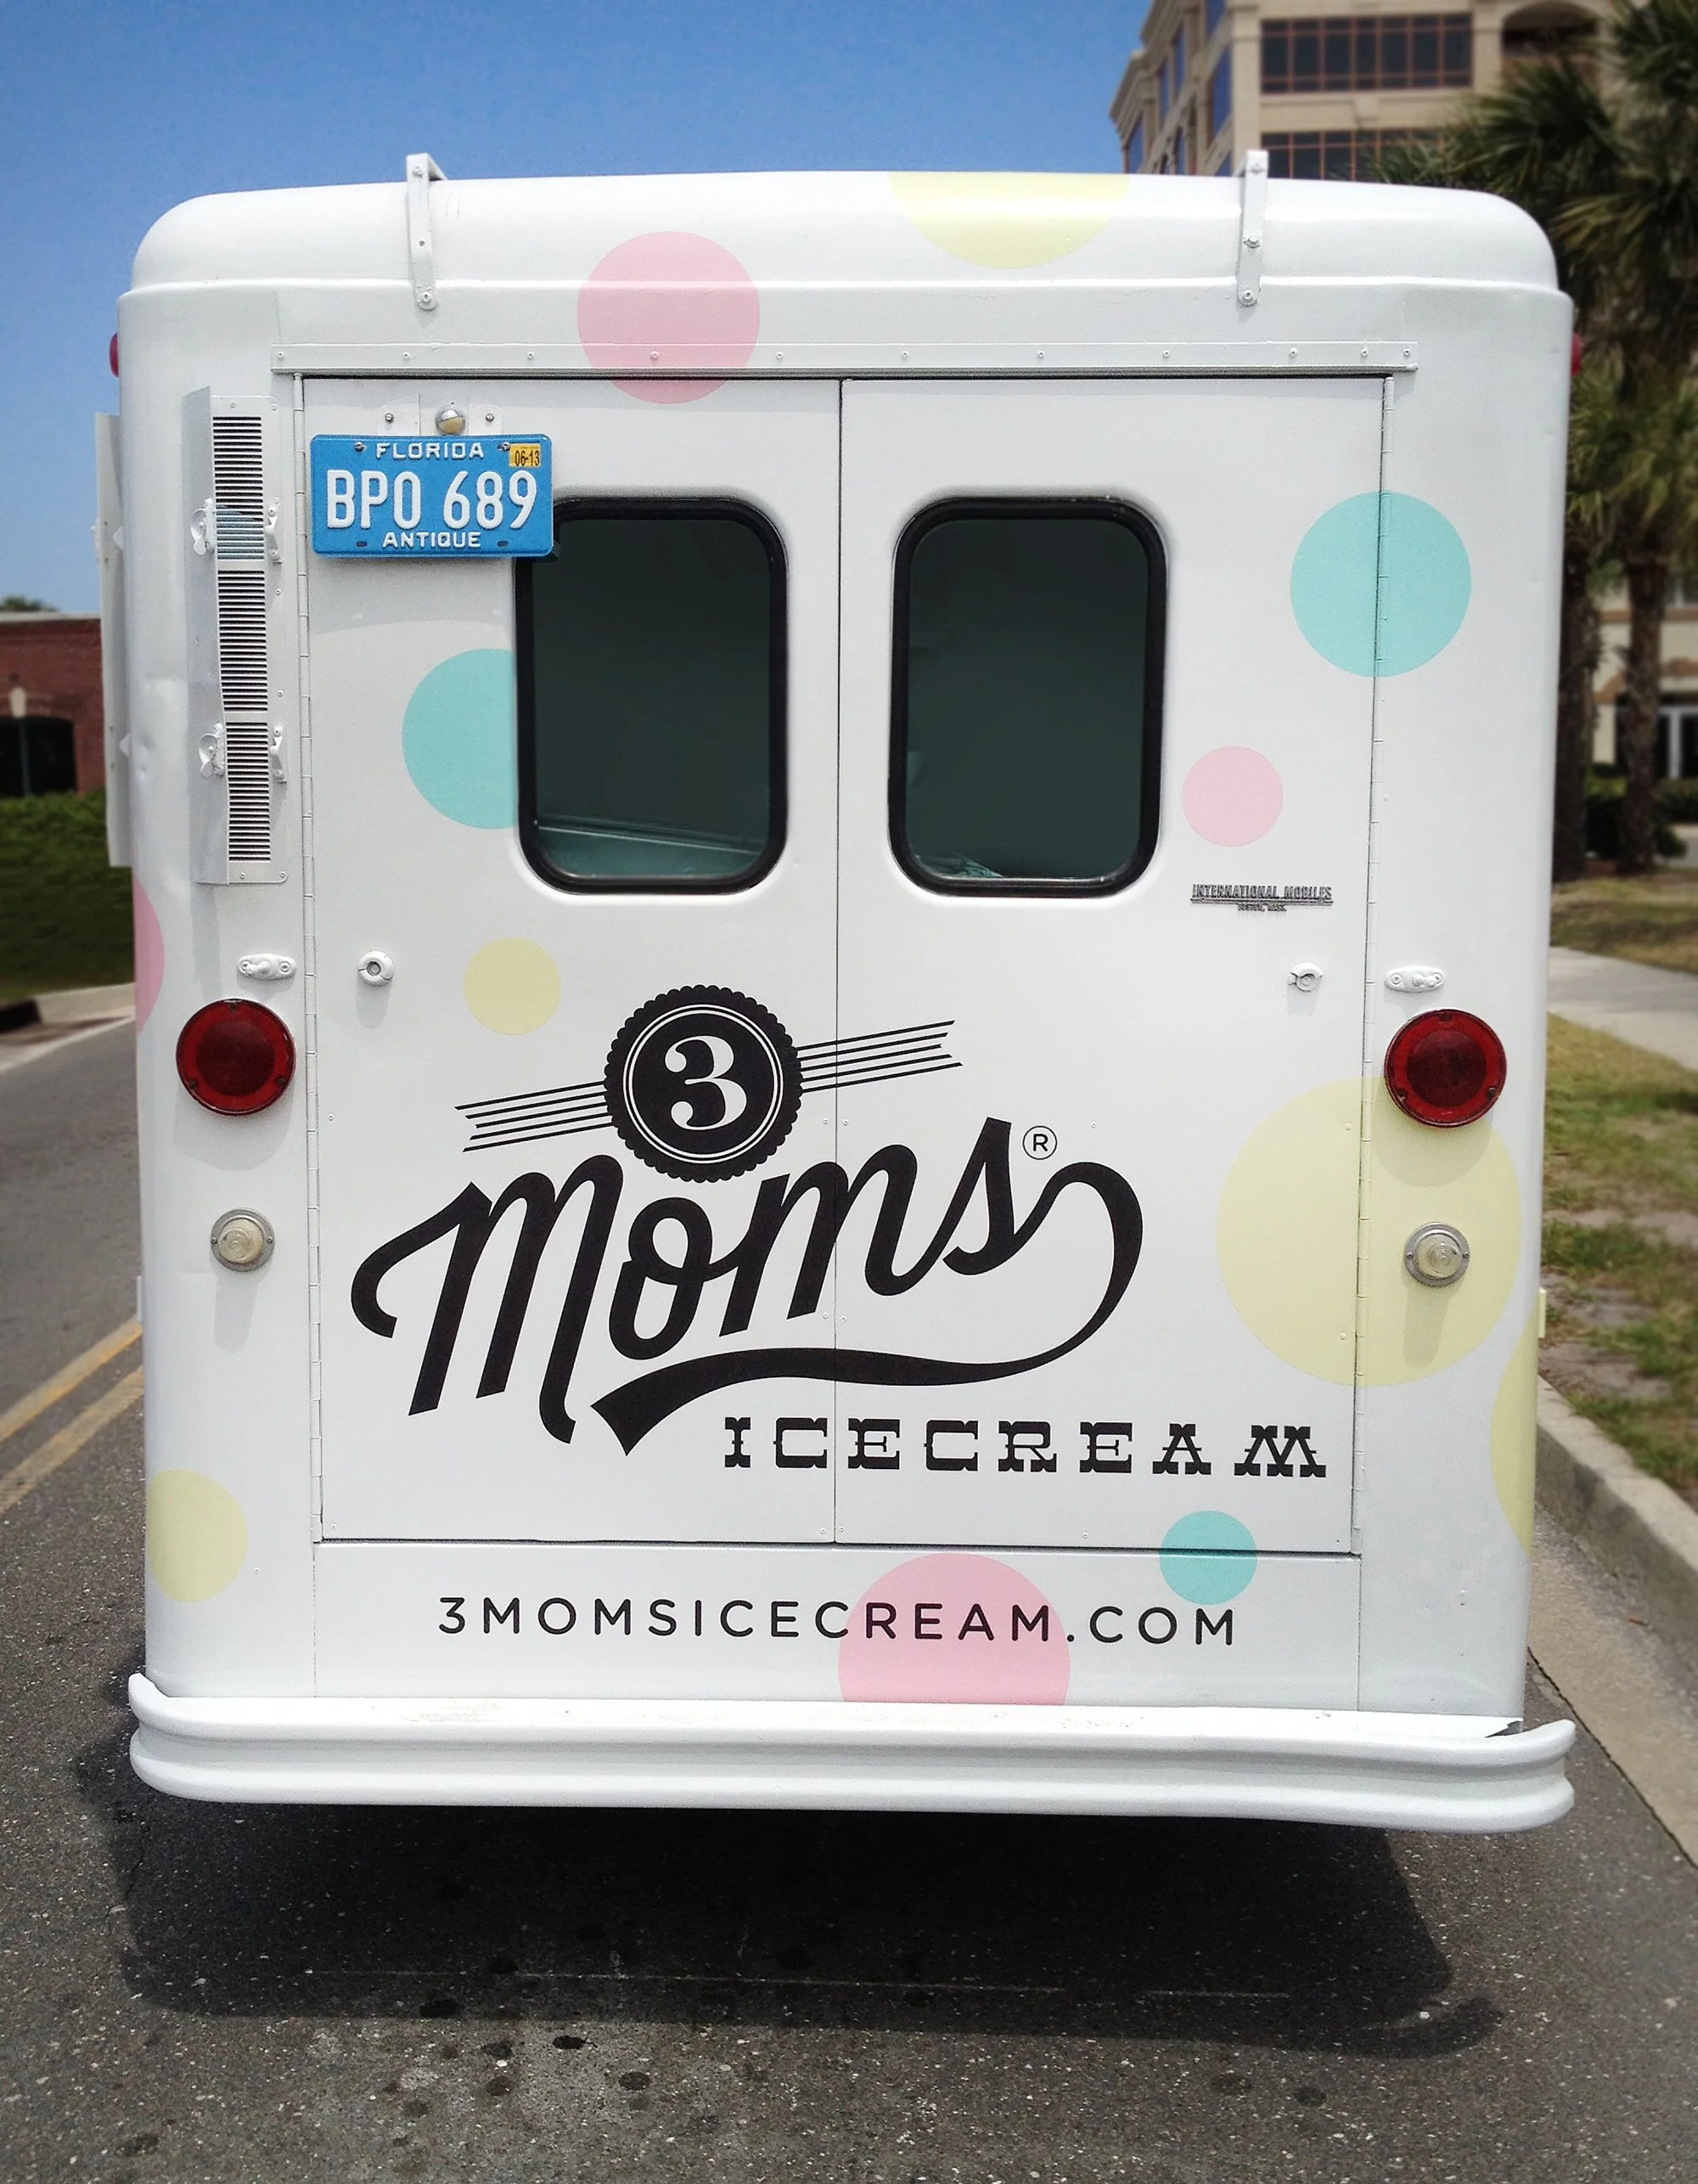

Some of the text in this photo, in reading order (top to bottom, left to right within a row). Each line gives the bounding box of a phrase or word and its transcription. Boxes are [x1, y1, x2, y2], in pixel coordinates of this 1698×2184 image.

[375, 442, 484, 459] FLORIDA
[514, 450, 540, 467] 06-13
[443, 470, 537, 529] 689
[382, 531, 481, 548] ANTIQUE
[1191, 884, 1278, 898] INTERNATIONAL
[664, 1035, 747, 1131] 3
[724, 1416, 1327, 1478] ICECREAM
[438, 1596, 1234, 1646] 3MOMSICECREAM.COM
